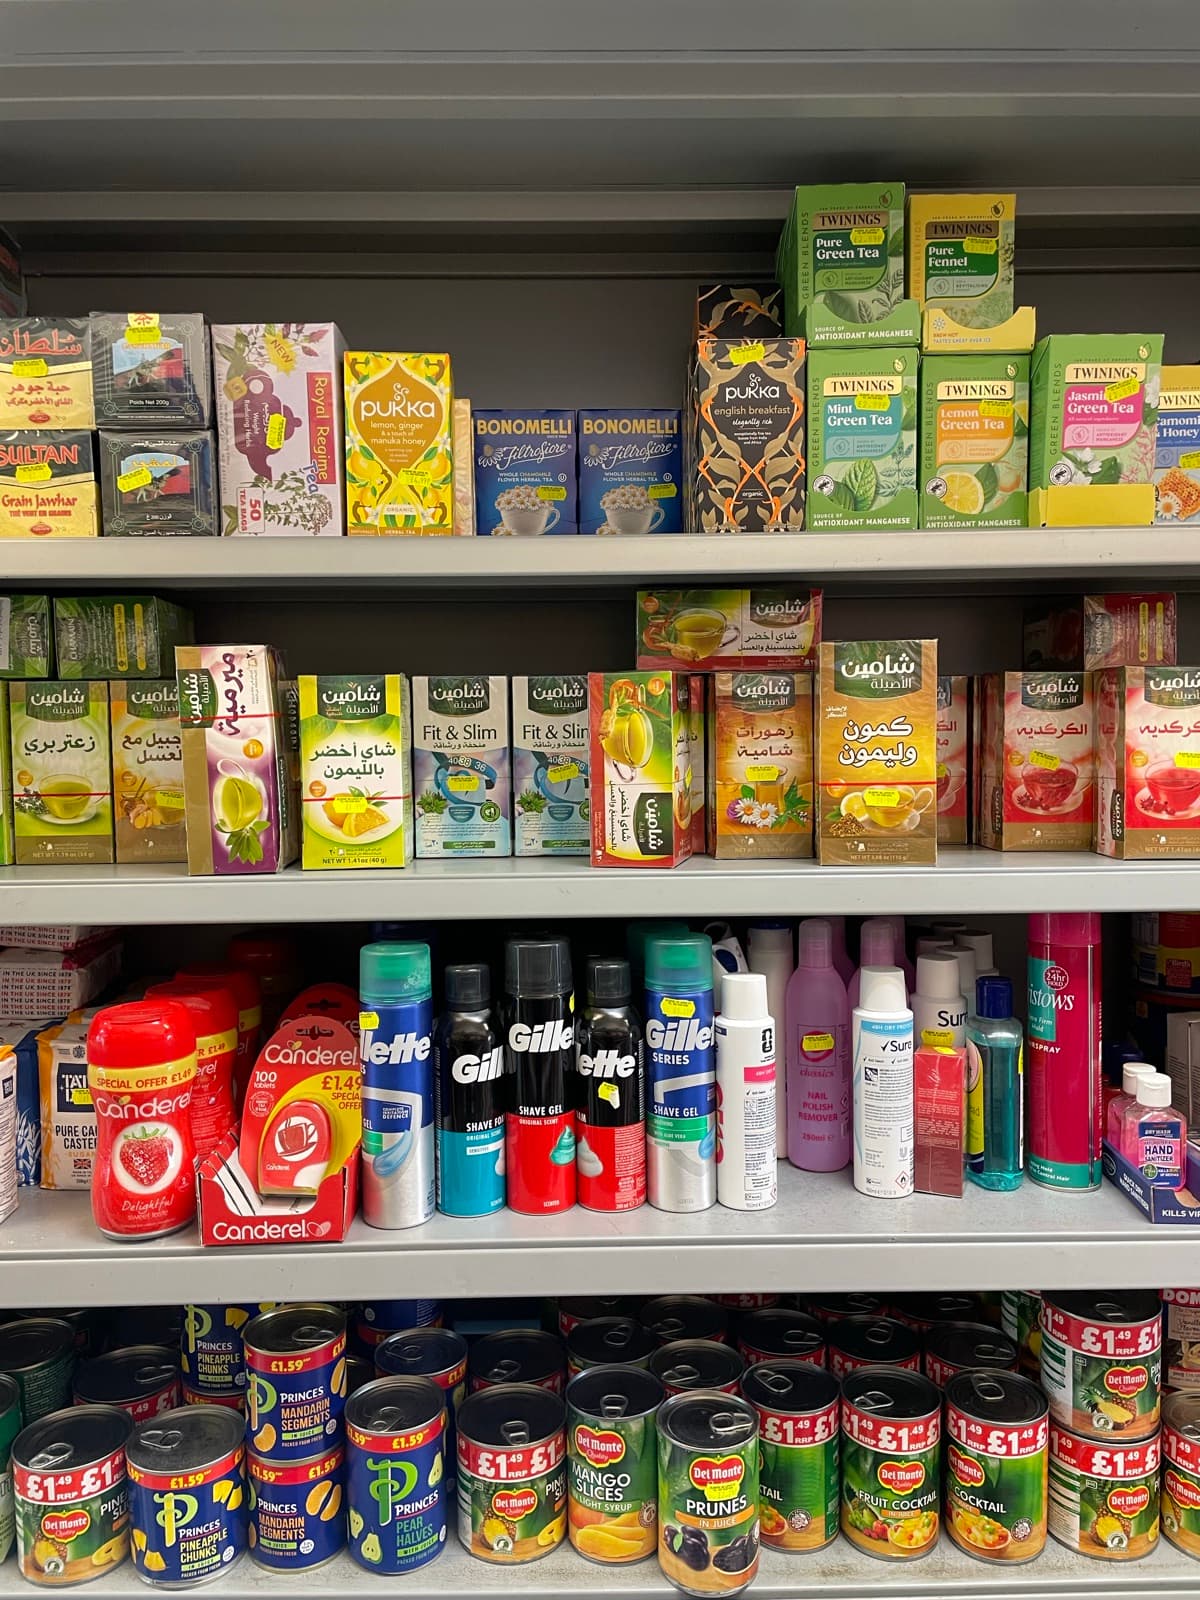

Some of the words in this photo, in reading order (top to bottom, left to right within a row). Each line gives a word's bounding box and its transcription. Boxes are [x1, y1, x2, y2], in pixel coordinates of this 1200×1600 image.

[820, 213, 881, 227] TWININGS
[932, 222, 993, 235] TWININGS
[816, 238, 842, 248] Pure
[816, 248, 855, 260] Green
[857, 247, 880, 259] Tea
[928, 246, 955, 256] Pure
[928, 257, 968, 268] Fennel
[815, 332, 866, 341] ANTIOXIDANT
[868, 329, 914, 340] MANGANESE
[271, 339, 293, 364] NEW
[725, 384, 780, 402] pukka
[831, 380, 894, 392] TWININGS
[944, 384, 1007, 396] TWININGS
[313, 377, 328, 419] Royal
[1068, 391, 1106, 402] Jasmi
[361, 399, 435, 421] pukka
[714, 405, 747, 417] english
[748, 405, 791, 415] breakfast
[827, 404, 852, 414] Mint
[940, 408, 978, 418] Lemon
[370, 421, 397, 431] lemon,
[399, 422, 423, 432] ginger
[477, 419, 572, 435] BONOMELLI
[583, 419, 678, 435] BONOMELLI
[827, 415, 867, 426] Green
[869, 414, 893, 425] Tea
[940, 419, 981, 431] Green
[983, 418, 1005, 430] Tea
[1163, 428, 1199, 438] Honey
[371, 437, 401, 446] manuka
[402, 437, 426, 447] honey
[0, 445, 79, 464] SULTAN
[312, 426, 328, 481] Regime
[303, 459, 319, 494] Tea
[2, 493, 33, 508] Grain
[35, 493, 78, 508] Jawhar
[742, 490, 763, 498] organic
[249, 498, 262, 522] 50
[813, 519, 864, 527] ANTIOXIDANT
[866, 517, 910, 525] MANGANESE
[775, 632, 797, 643] شاي
[31, 689, 85, 708] شامين
[185, 673, 202, 725] شامين
[322, 684, 381, 705] شامين
[432, 683, 485, 701] شامين
[532, 683, 584, 701] شامين
[423, 725, 441, 741] Fit
[446, 726, 459, 740] &
[464, 724, 497, 741] Slim
[736, 726, 794, 741] زهورات
[843, 716, 913, 743] كمون
[1017, 723, 1088, 738] الكركديه
[737, 743, 793, 760] شامية
[838, 742, 918, 767] وليمون
[323, 762, 385, 780] بالليمون
[448, 757, 459, 765] 40
[459, 756, 472, 767] 38
[474, 761, 486, 772] 36
[1046, 972, 1066, 982] 24hr
[1028, 984, 1075, 1011] istows
[937, 1010, 968, 1027] Sur
[509, 1020, 574, 1053] Gille
[890, 1040, 912, 1052] Sure
[265, 1045, 358, 1066] Canderel
[652, 1052, 690, 1065] SERIES
[96, 1076, 133, 1089] SPECIAL
[135, 1075, 168, 1089] OFFER
[255, 1071, 277, 1082] 100
[254, 1081, 276, 1089] tablets
[96, 1086, 192, 1119] Canderel
[807, 1091, 828, 1100] NAIL
[519, 1105, 546, 1116] SHAVE
[549, 1104, 563, 1114] GEL
[653, 1104, 681, 1117] SHAVE
[683, 1106, 699, 1117] GEL
[802, 1102, 834, 1111] POLISH
[798, 1112, 838, 1121] REMOVER
[55, 1125, 79, 1137] PURE
[466, 1120, 493, 1132] SHAVE
[1145, 1145, 1174, 1155] HAND
[122, 1197, 174, 1215] Delightful
[1162, 1209, 1187, 1217] KILLS
[213, 1221, 306, 1240] Canderel
[197, 1341, 232, 1351] PRINCES
[1115, 1347, 1136, 1355] RRP
[197, 1353, 241, 1364] PINEAPPLE
[271, 1359, 304, 1372] £1.59
[198, 1363, 229, 1375] CHUNKS
[1107, 1374, 1121, 1384] Del
[1122, 1372, 1146, 1384] Monte
[280, 1386, 324, 1403] PRINCES
[281, 1398, 331, 1419] MANDARIN
[281, 1411, 331, 1432] SEGMENTS
[309, 1458, 337, 1479] £1.59
[508, 1469, 528, 1479] RRP
[571, 1461, 631, 1488] MANGO
[170, 1472, 204, 1489] £1.59
[56, 1491, 77, 1501] RRP
[576, 1480, 624, 1501] SLICES
[495, 1497, 508, 1508] Del
[509, 1495, 536, 1507] Monte
[579, 1497, 603, 1512] LIGHT
[604, 1503, 632, 1512] SYRUP
[686, 1494, 747, 1517] PRUNES
[858, 1490, 888, 1509] FRUIT
[892, 1490, 938, 1511] COCKTAIL
[954, 1486, 1007, 1514] COCKTAIL
[44, 1519, 57, 1531] Del
[59, 1516, 87, 1528] Monte
[178, 1519, 221, 1538] PRINCES
[396, 1515, 424, 1534] PEAR
[699, 1518, 710, 1528] IN
[712, 1516, 737, 1527] JUICE
[180, 1528, 228, 1553] PINEAPPLE
[397, 1524, 433, 1547] HALVES
[180, 1545, 218, 1563] CHUNKS
